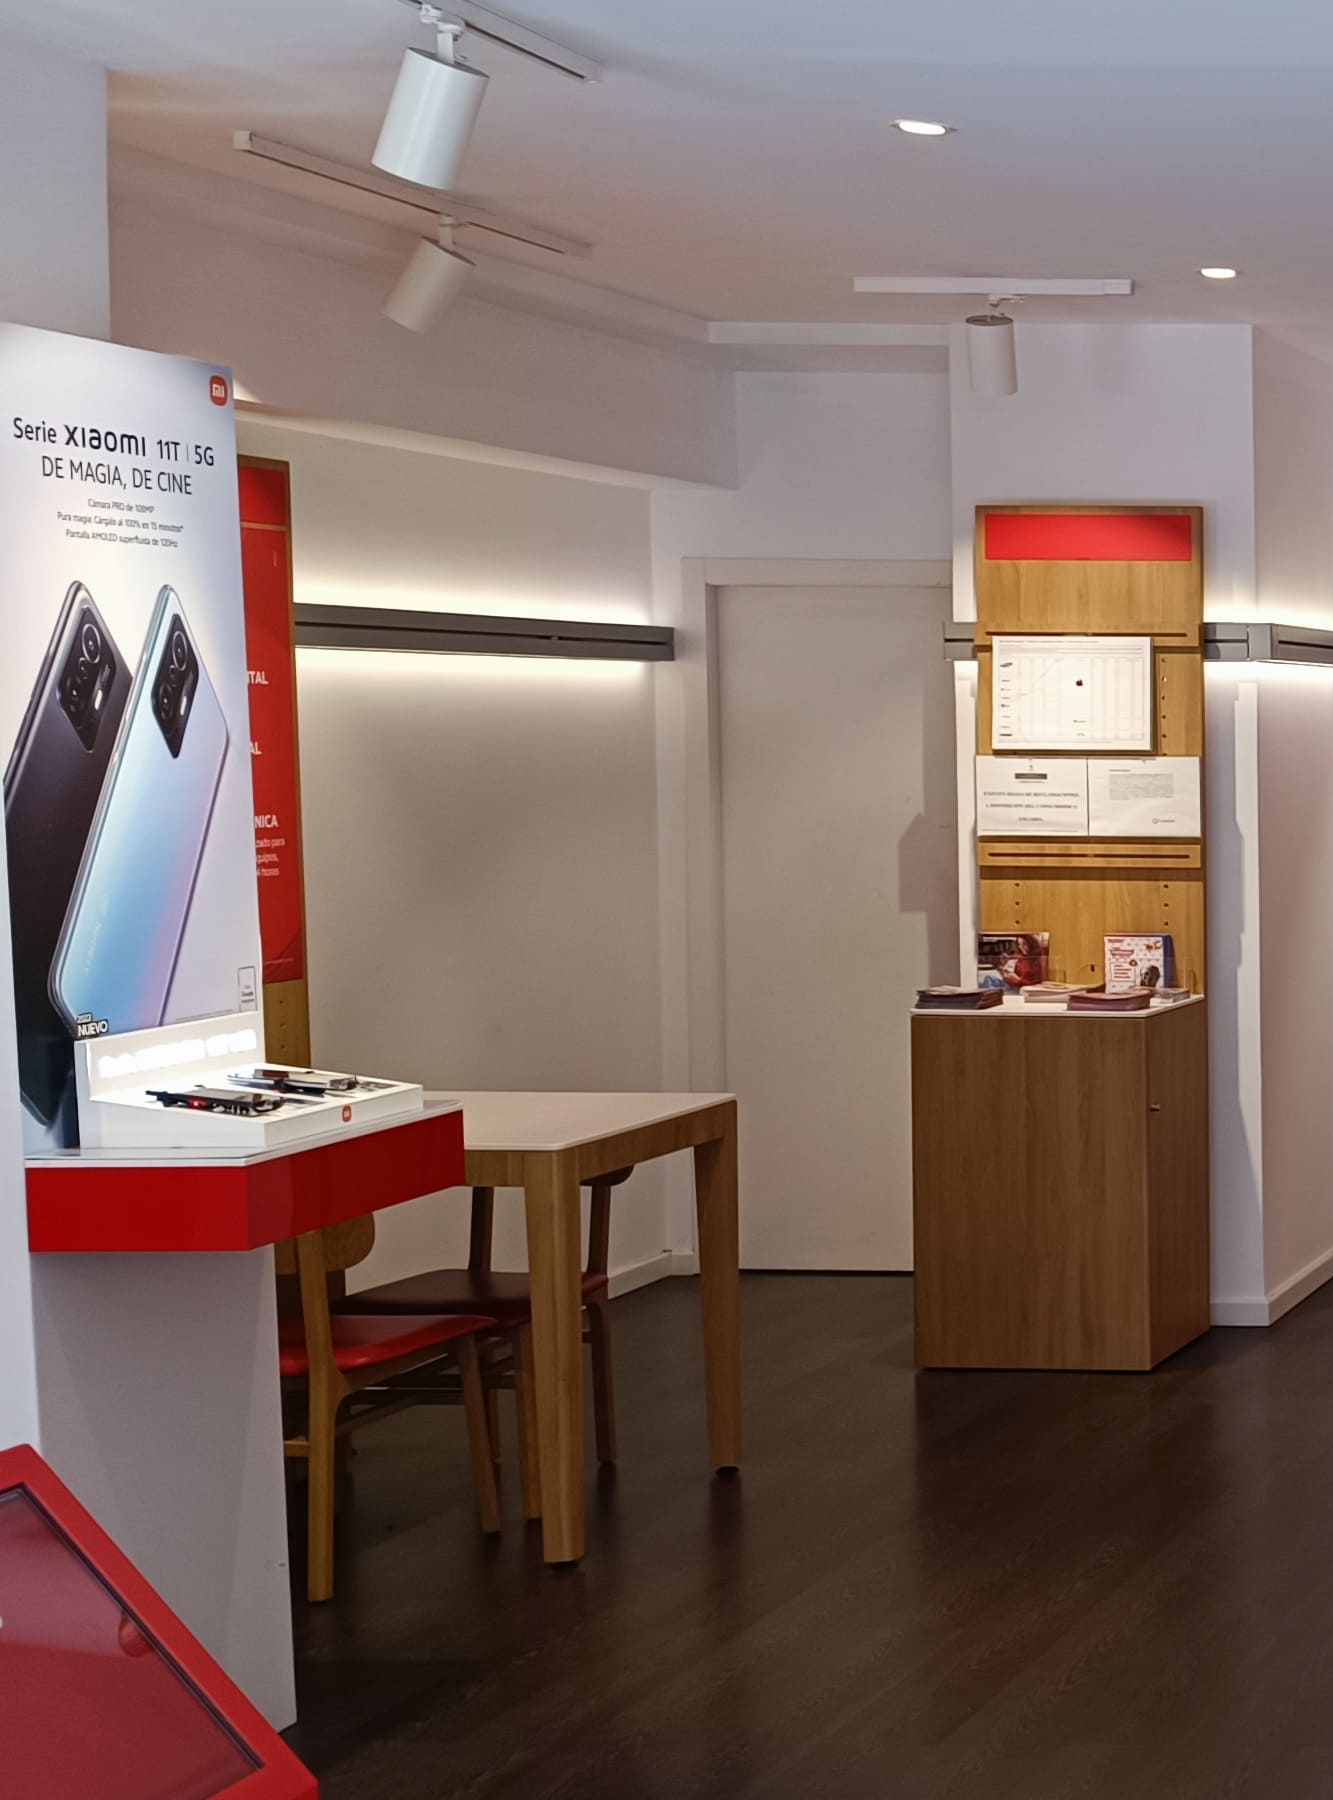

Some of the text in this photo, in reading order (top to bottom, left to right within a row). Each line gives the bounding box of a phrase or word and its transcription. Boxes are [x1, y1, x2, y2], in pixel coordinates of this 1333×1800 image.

[13, 417, 57, 444] Serie
[156, 439, 181, 462] 11T
[194, 444, 215, 467] 5G
[42, 456, 193, 495] DE MAGIA, DE CINE
[78, 1021, 108, 1036] NUEVO
